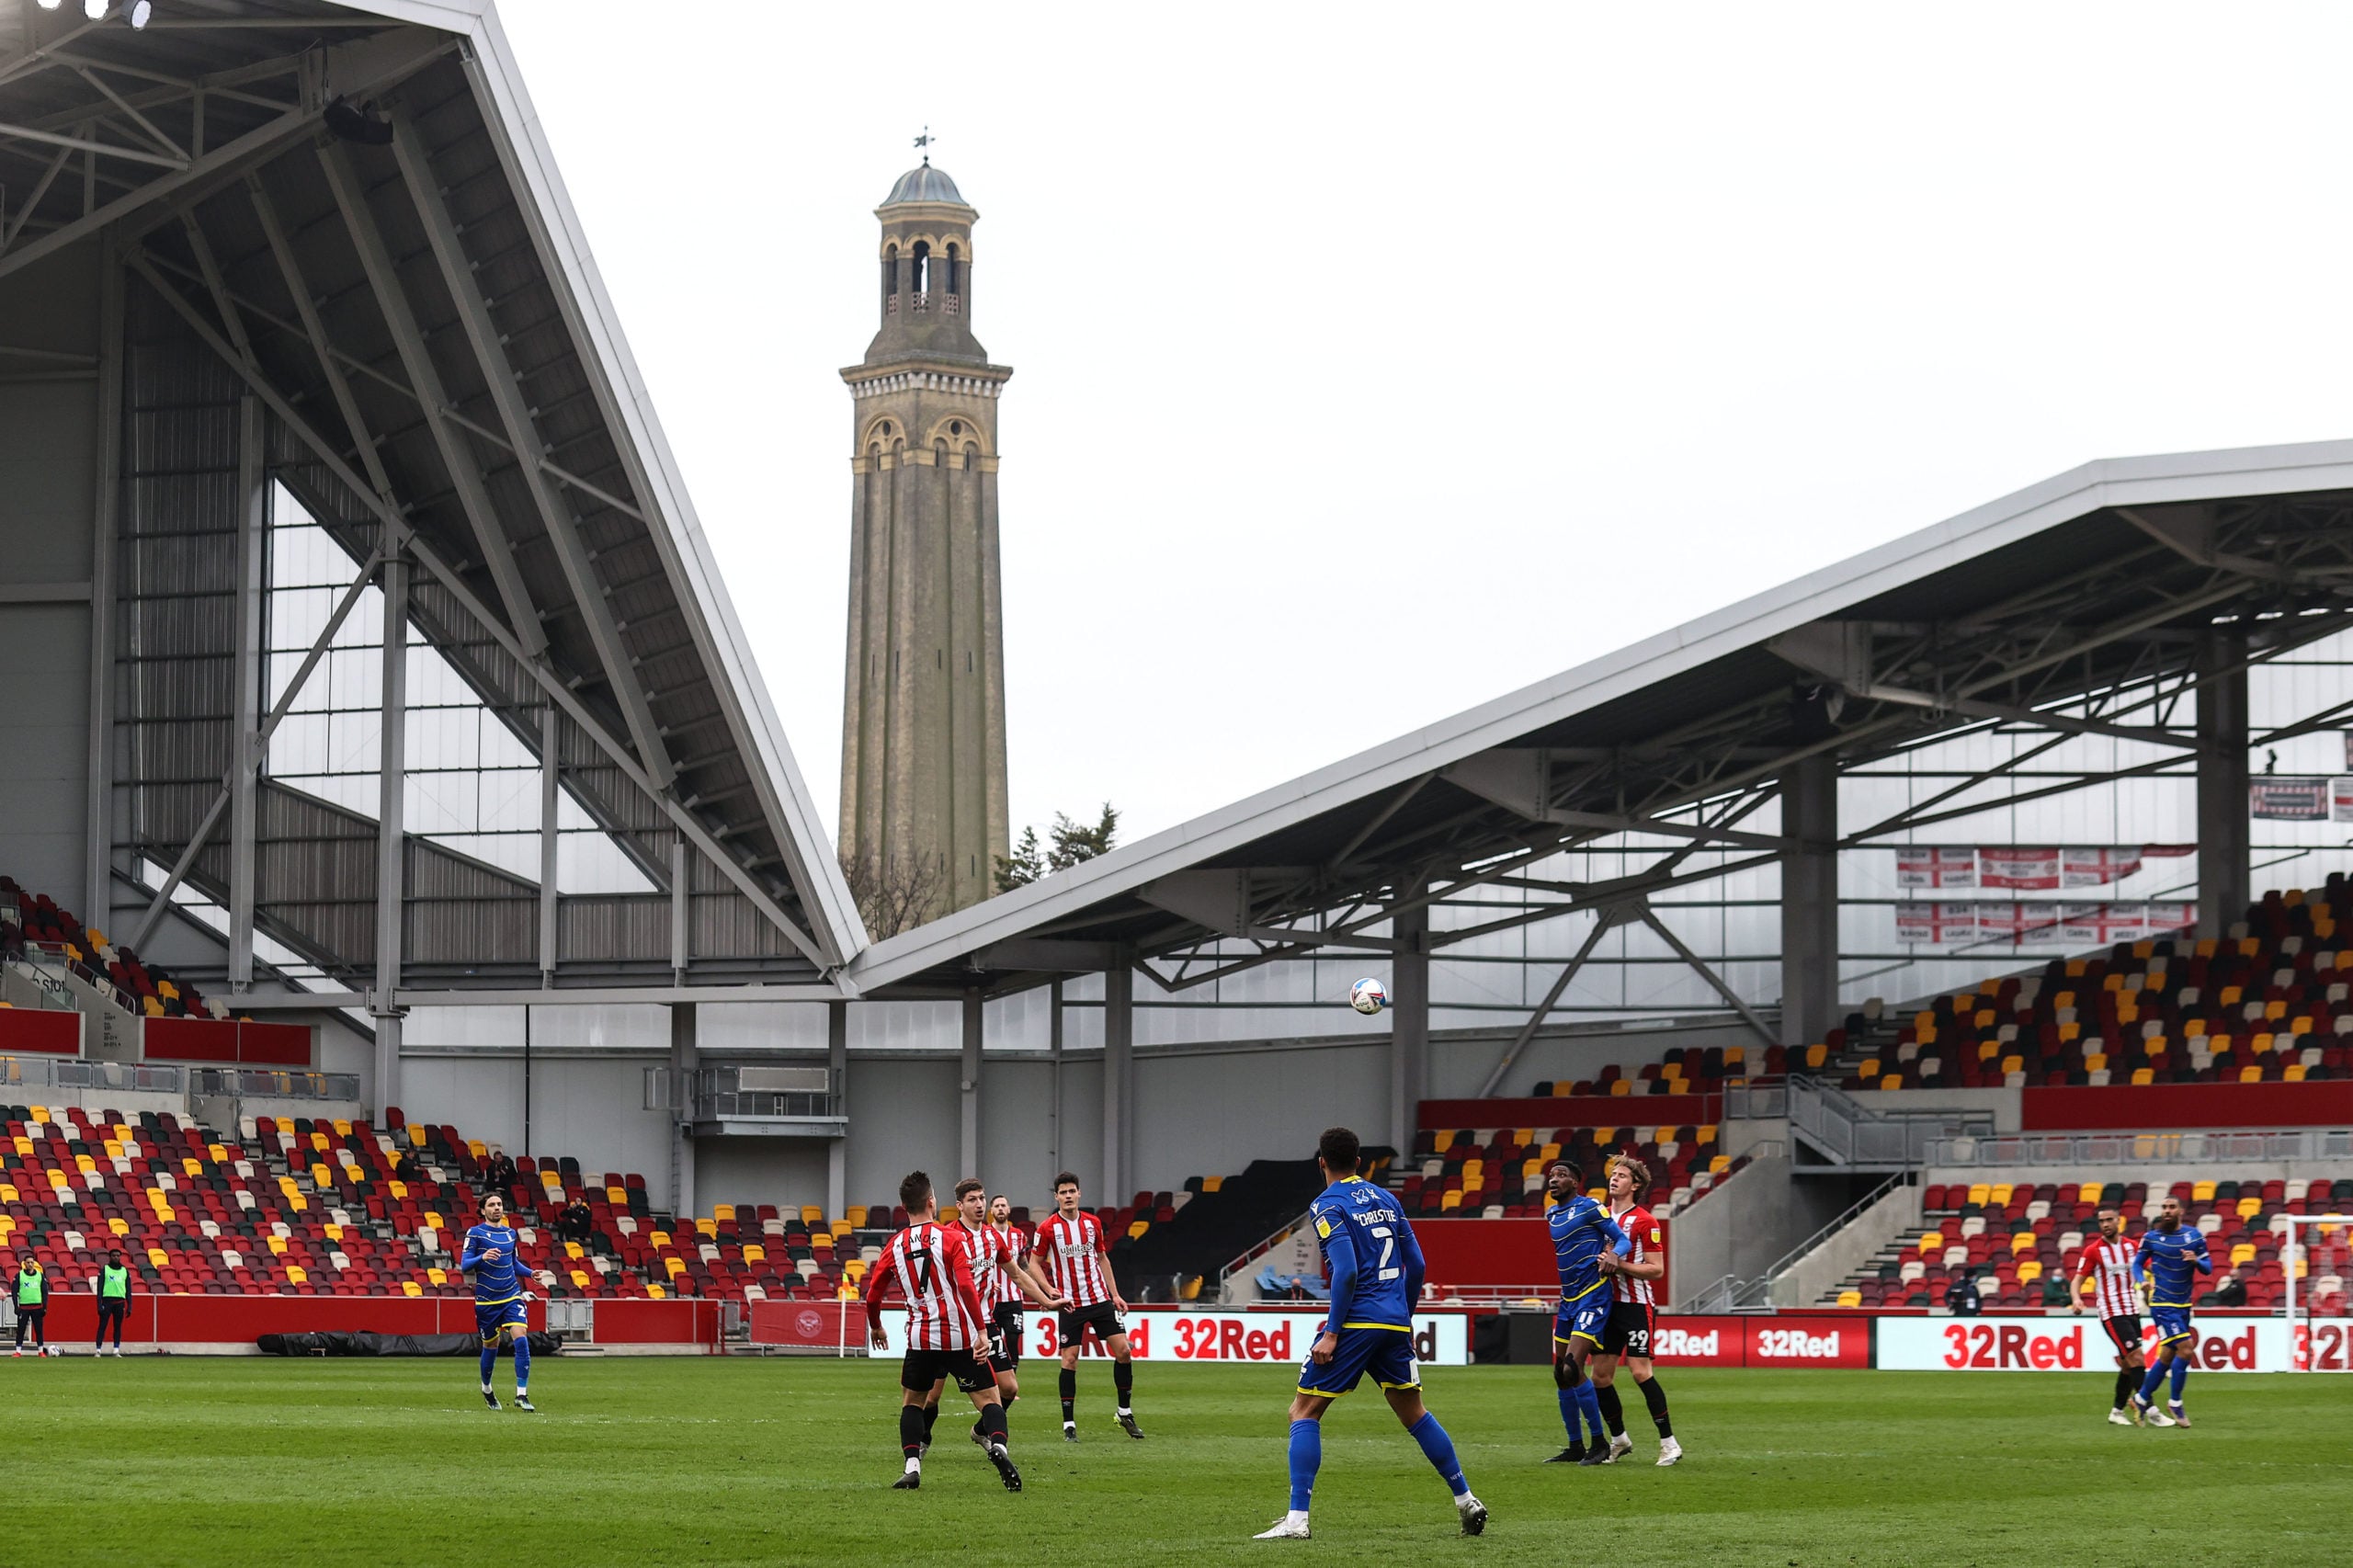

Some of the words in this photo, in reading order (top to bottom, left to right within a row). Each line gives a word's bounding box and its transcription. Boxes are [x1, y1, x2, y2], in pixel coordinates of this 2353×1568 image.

[1358, 1210, 1397, 1227] CHRISTIE
[905, 1248, 932, 1294] 7
[1371, 1226, 1399, 1281] 2
[1578, 1311, 1596, 1325] 11
[1174, 1318, 1290, 1360] 32Red
[1628, 1330, 1649, 1347] 29
[1653, 1329, 1719, 1357] 2Red
[1757, 1330, 1839, 1358] 32Red
[1944, 1324, 2083, 1369] 32Red
[2293, 1324, 2353, 1370] 32
